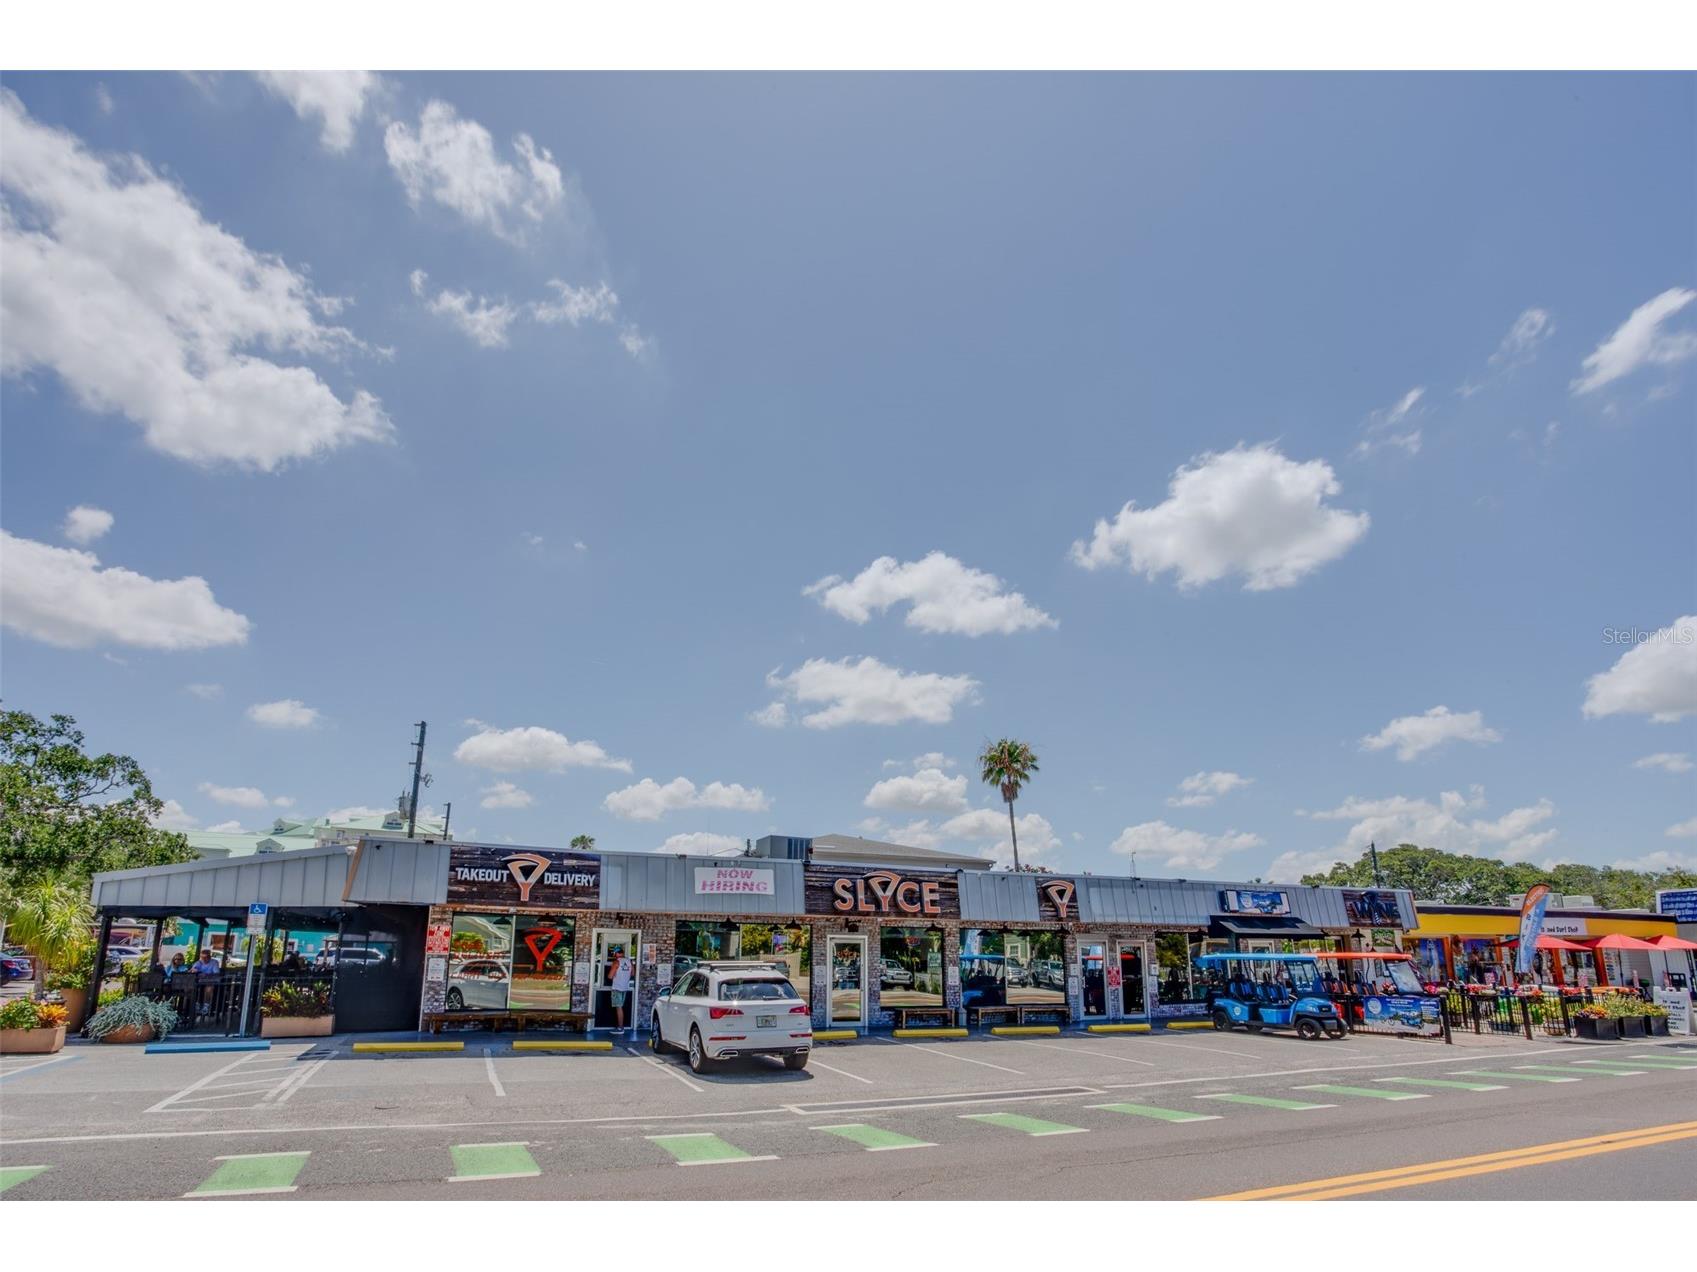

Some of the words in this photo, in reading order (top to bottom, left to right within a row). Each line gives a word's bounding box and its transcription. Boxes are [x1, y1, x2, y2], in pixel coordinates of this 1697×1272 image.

[455, 867, 510, 884] TAKEOUT
[544, 872, 596, 887] DELIVERY
[716, 869, 754, 879] NOW
[701, 880, 768, 892] HIRING
[833, 870, 942, 914] SLYCE
